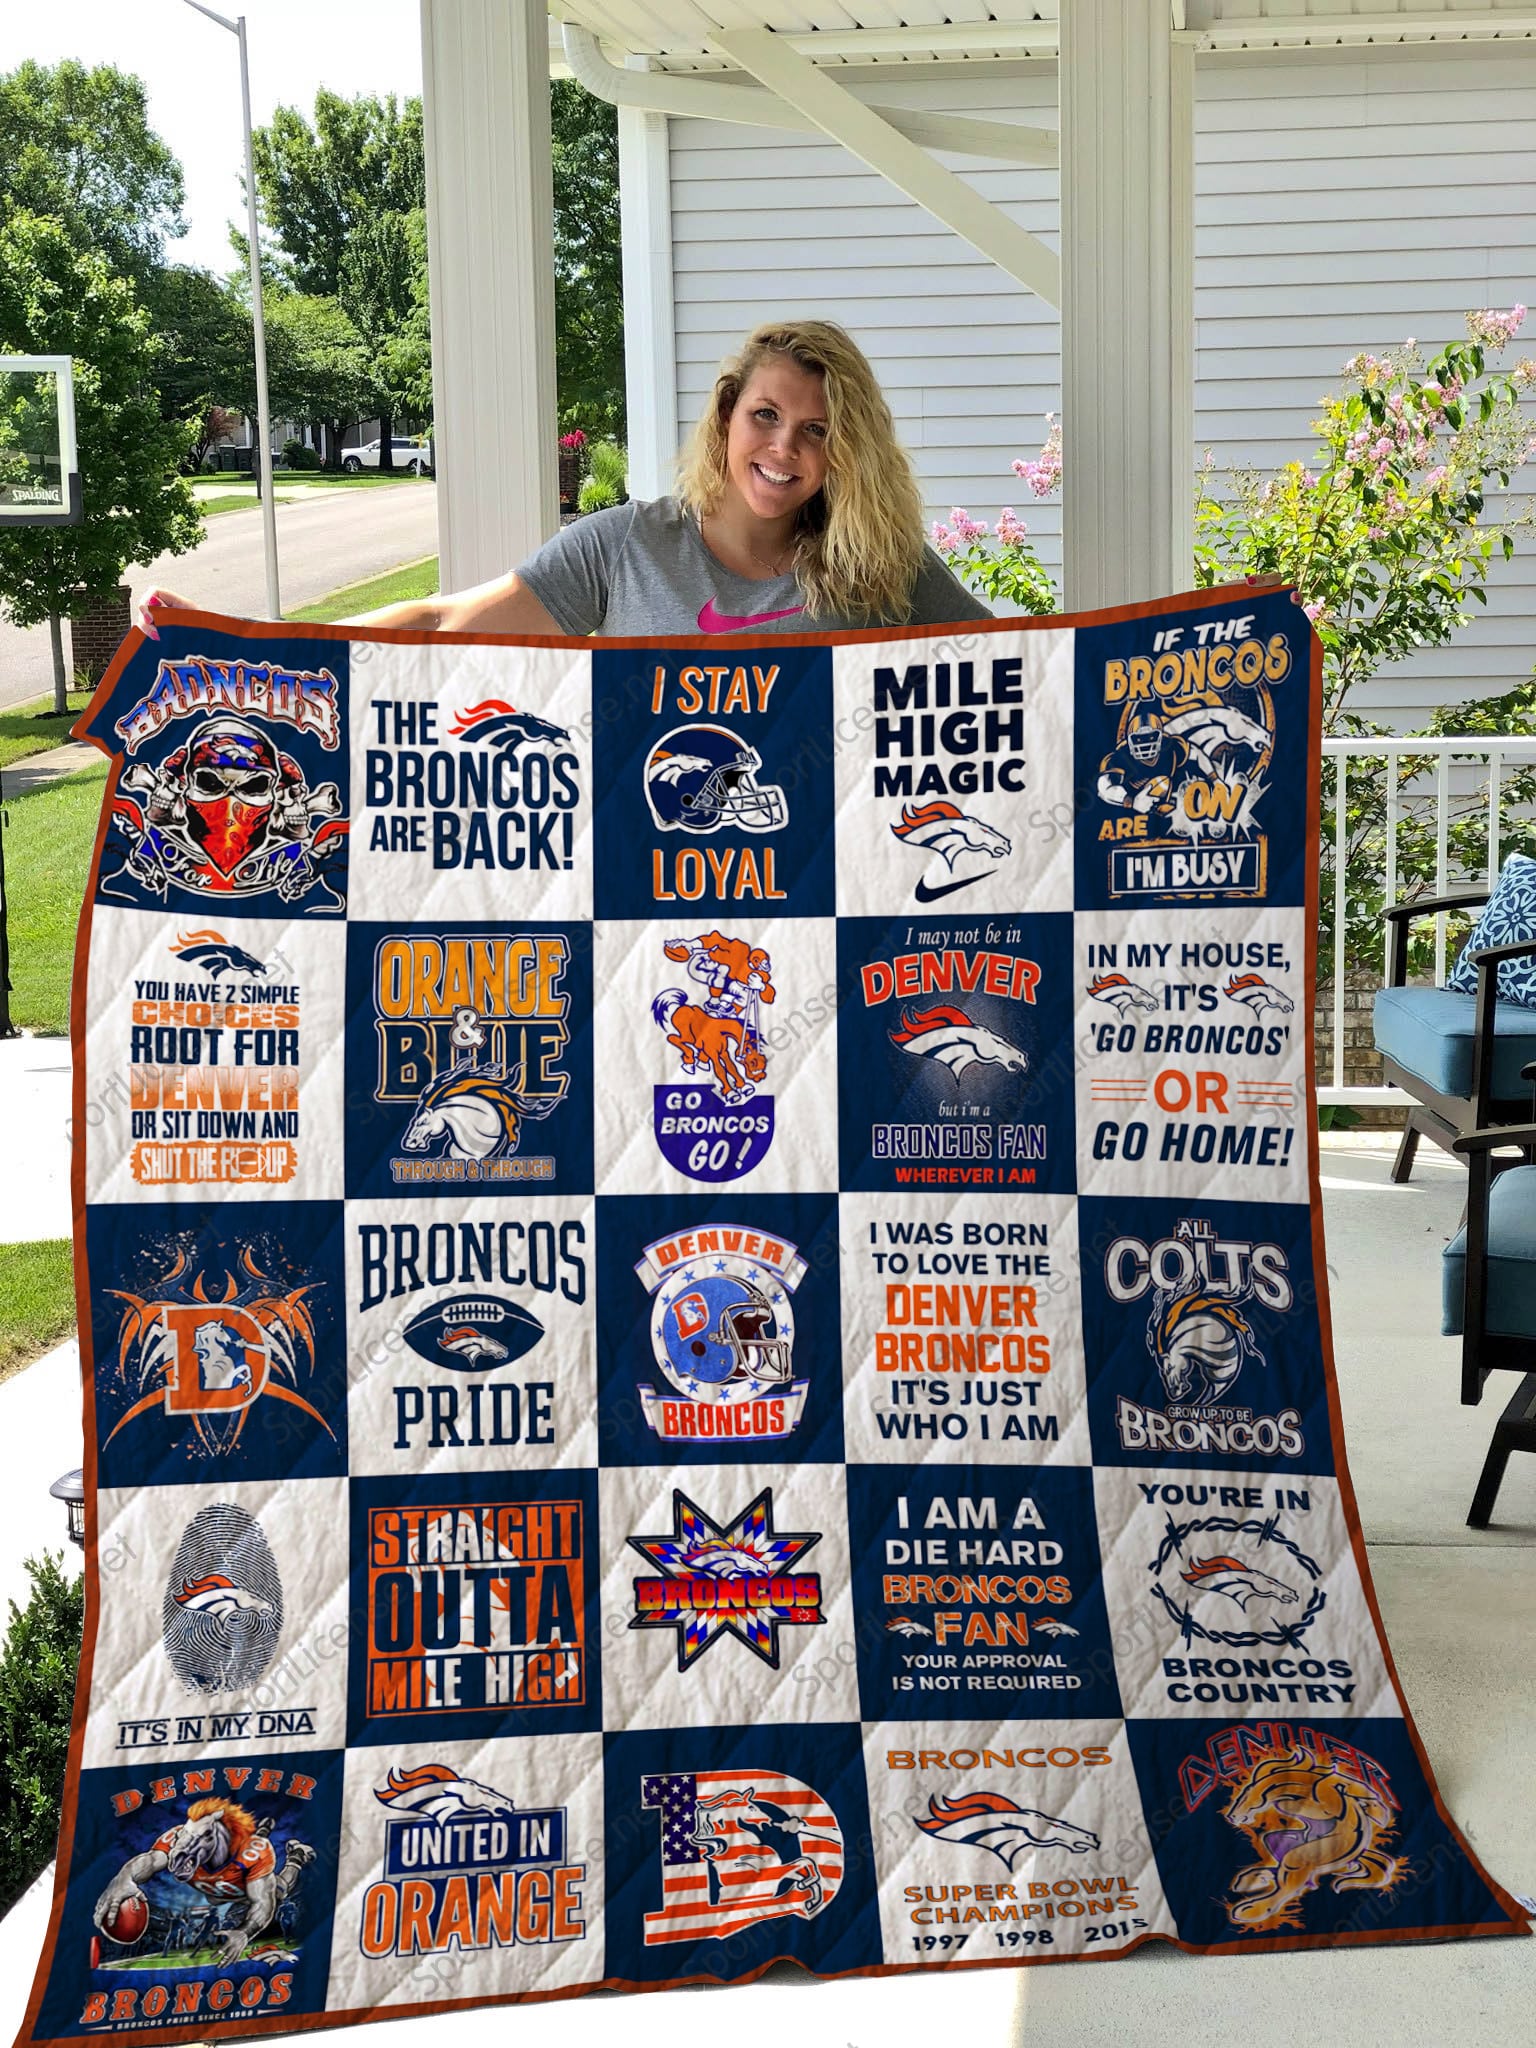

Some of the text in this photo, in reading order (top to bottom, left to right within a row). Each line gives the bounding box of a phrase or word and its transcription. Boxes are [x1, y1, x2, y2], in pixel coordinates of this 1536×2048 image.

[12, 490, 60, 501] SPALDING
[1153, 615, 1256, 652] IF THE
[874, 658, 1023, 711] MILE
[1104, 633, 1292, 705] BRONCOS
[114, 654, 340, 755] BRONCOS
[652, 665, 780, 714] I STAY
[371, 700, 438, 745] THE
[876, 709, 1023, 758] HIGH
[366, 750, 579, 809] BRONCOS
[874, 759, 1026, 797] MAGIC
[1183, 779, 1247, 822] ON
[369, 812, 573, 870] ARE BACK!
[1098, 815, 1149, 841] ARE
[653, 848, 787, 901] LOYAL
[1126, 851, 1245, 889] I'M BUSY
[905, 923, 1021, 951] I may not be in
[1088, 943, 1291, 972] IN MY HOUSE,
[134, 981, 300, 1004] YOU HAVE 2 SIMPLE
[377, 938, 570, 1017] ORANGE
[861, 951, 1041, 1007] DENVER
[132, 1001, 300, 1028] CHOICES
[1164, 984, 1219, 1011] IT'S
[451, 1007, 486, 1047] &
[131, 1026, 299, 1066] ROOT FOR
[130, 1065, 299, 1110] DENVER
[666, 1092, 701, 1110] GO
[1154, 1070, 1229, 1114] OR
[132, 1111, 298, 1139] OR SIT DOWN AND
[660, 1115, 770, 1135] BRONCOS
[938, 1100, 958, 1117] but
[983, 1107, 990, 1117] a
[688, 1139, 728, 1172] GO
[872, 1124, 1046, 1159] BRONCOS FAN
[1092, 1122, 1294, 1167] GO HOME!
[141, 1147, 182, 1179] SHUT
[186, 1147, 217, 1178] THE
[266, 1147, 287, 1178] UP
[392, 1158, 553, 1180] THROUGH & THROUGH
[895, 1168, 1036, 1184] WHEREVER I AM
[870, 1222, 1047, 1246] I WAS BORN
[1174, 1218, 1217, 1240] ALL
[656, 1231, 785, 1267] DENVER
[872, 1253, 1051, 1276] TO LOVE THE
[358, 1220, 586, 1313] BRONCOS
[1105, 1237, 1293, 1312] COLTS
[886, 1284, 1038, 1327] DENVER
[875, 1333, 1051, 1374] BRONCOS
[892, 1379, 1041, 1406] IT'S JUST
[393, 1382, 554, 1449] PRIDE
[663, 1400, 785, 1436] BRONCOS
[876, 1413, 1059, 1441] WHO I AM
[1116, 1395, 1304, 1457] BRONCOS
[1168, 1407, 1250, 1421] GROW UP TO BE
[897, 1497, 1046, 1530] I AM A
[1138, 1483, 1311, 1511] YOU'RE IN
[374, 1505, 577, 1565] STRAIGHT
[886, 1540, 1064, 1565] DIE HARD
[636, 1577, 820, 1611] BRONCOS
[883, 1575, 1072, 1604] BRONCOS
[374, 1565, 578, 1653] OUTTA
[935, 1612, 1029, 1646] FAN
[902, 1654, 1067, 1668] YOUR APPROVAL
[1162, 1658, 1353, 1678] BRONCOS
[372, 1651, 579, 1711] MILE HIGH
[893, 1675, 1082, 1690] IS NOT REQUIRED
[1167, 1683, 1357, 1703] COUNTRY
[118, 1712, 315, 1746] IT'S IN MY DNA
[886, 1746, 1112, 1770] BRONCOS
[111, 1767, 318, 1818] DENVER
[401, 1821, 509, 1867] UNITED
[519, 1818, 551, 1857] IN
[904, 1876, 1140, 1903] SUPER BOWL
[360, 1864, 586, 1959] ORANGE
[910, 1896, 1139, 1925] CHAMPIONS
[912, 1918, 1150, 1950] 1997 1998 2015
[79, 1973, 294, 2024] BRONCOS
